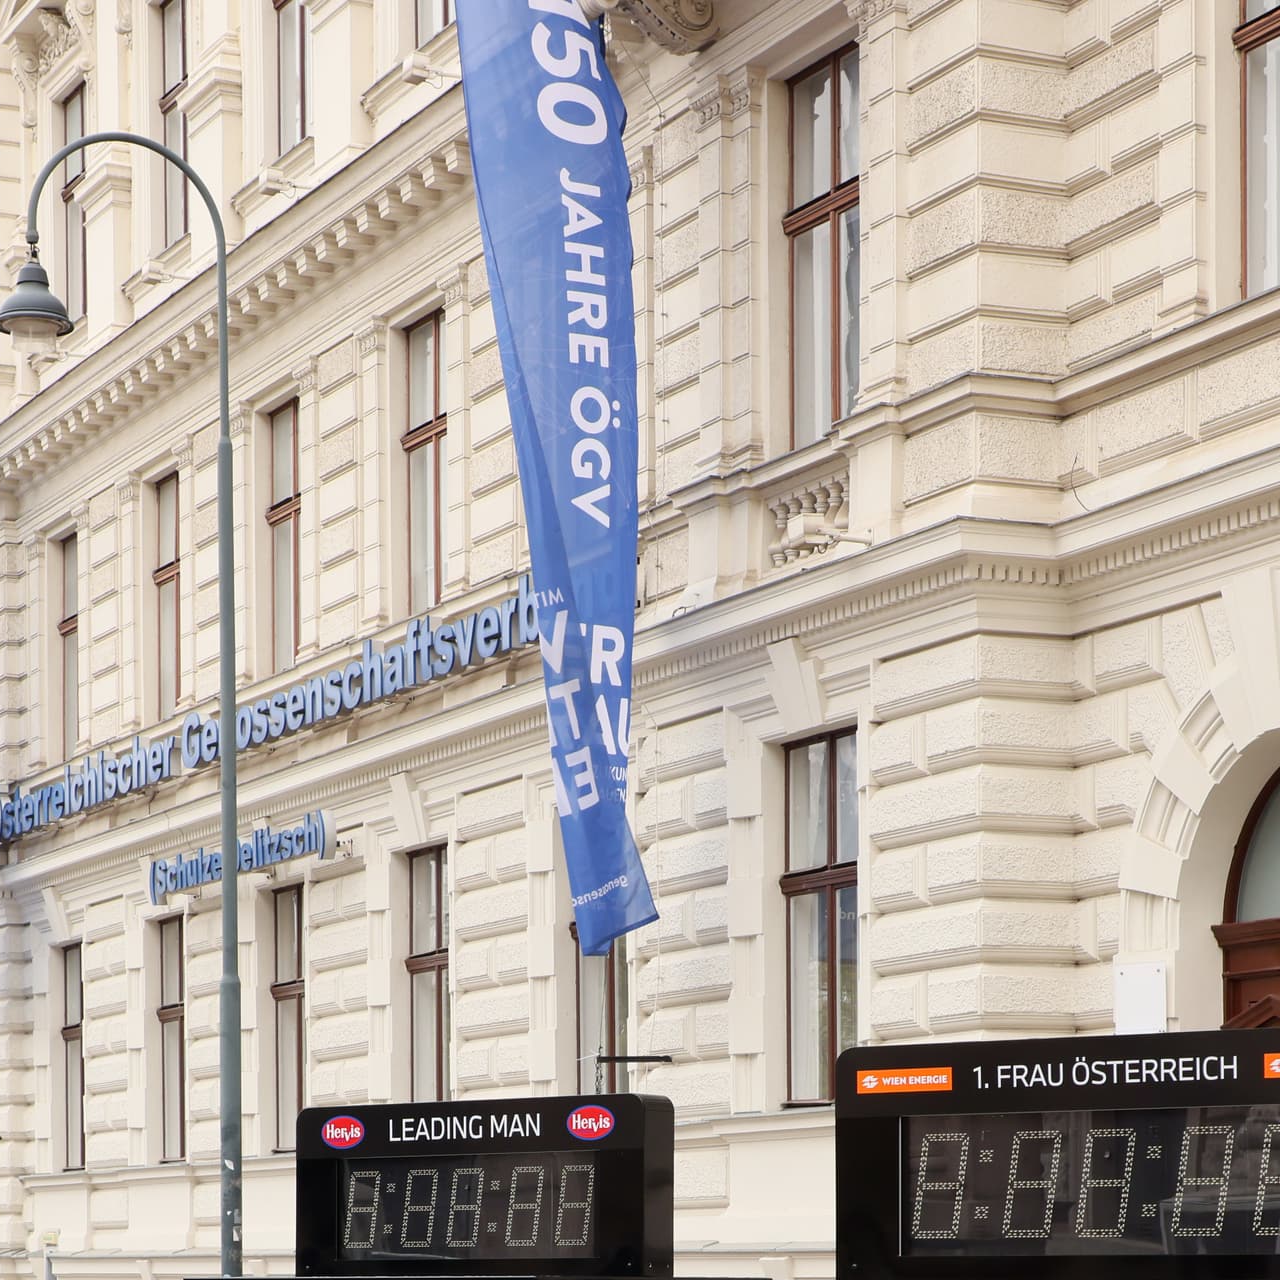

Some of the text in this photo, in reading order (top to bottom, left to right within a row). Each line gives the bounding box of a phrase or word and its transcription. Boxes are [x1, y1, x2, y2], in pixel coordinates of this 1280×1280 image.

[559, 167, 610, 369] JAHRE
[569, 384, 621, 530] ÖGV
[181, 573, 541, 769] Geossenschaftsverb
[880, 1073, 949, 1087] WIEN ENERGIE
[973, 1055, 1239, 1090] 1. FRAU ÖSTERREICH
[325, 1123, 361, 1142] Hervis
[388, 1112, 541, 1142] LEADING MAN
[571, 1113, 611, 1134] Hervis
